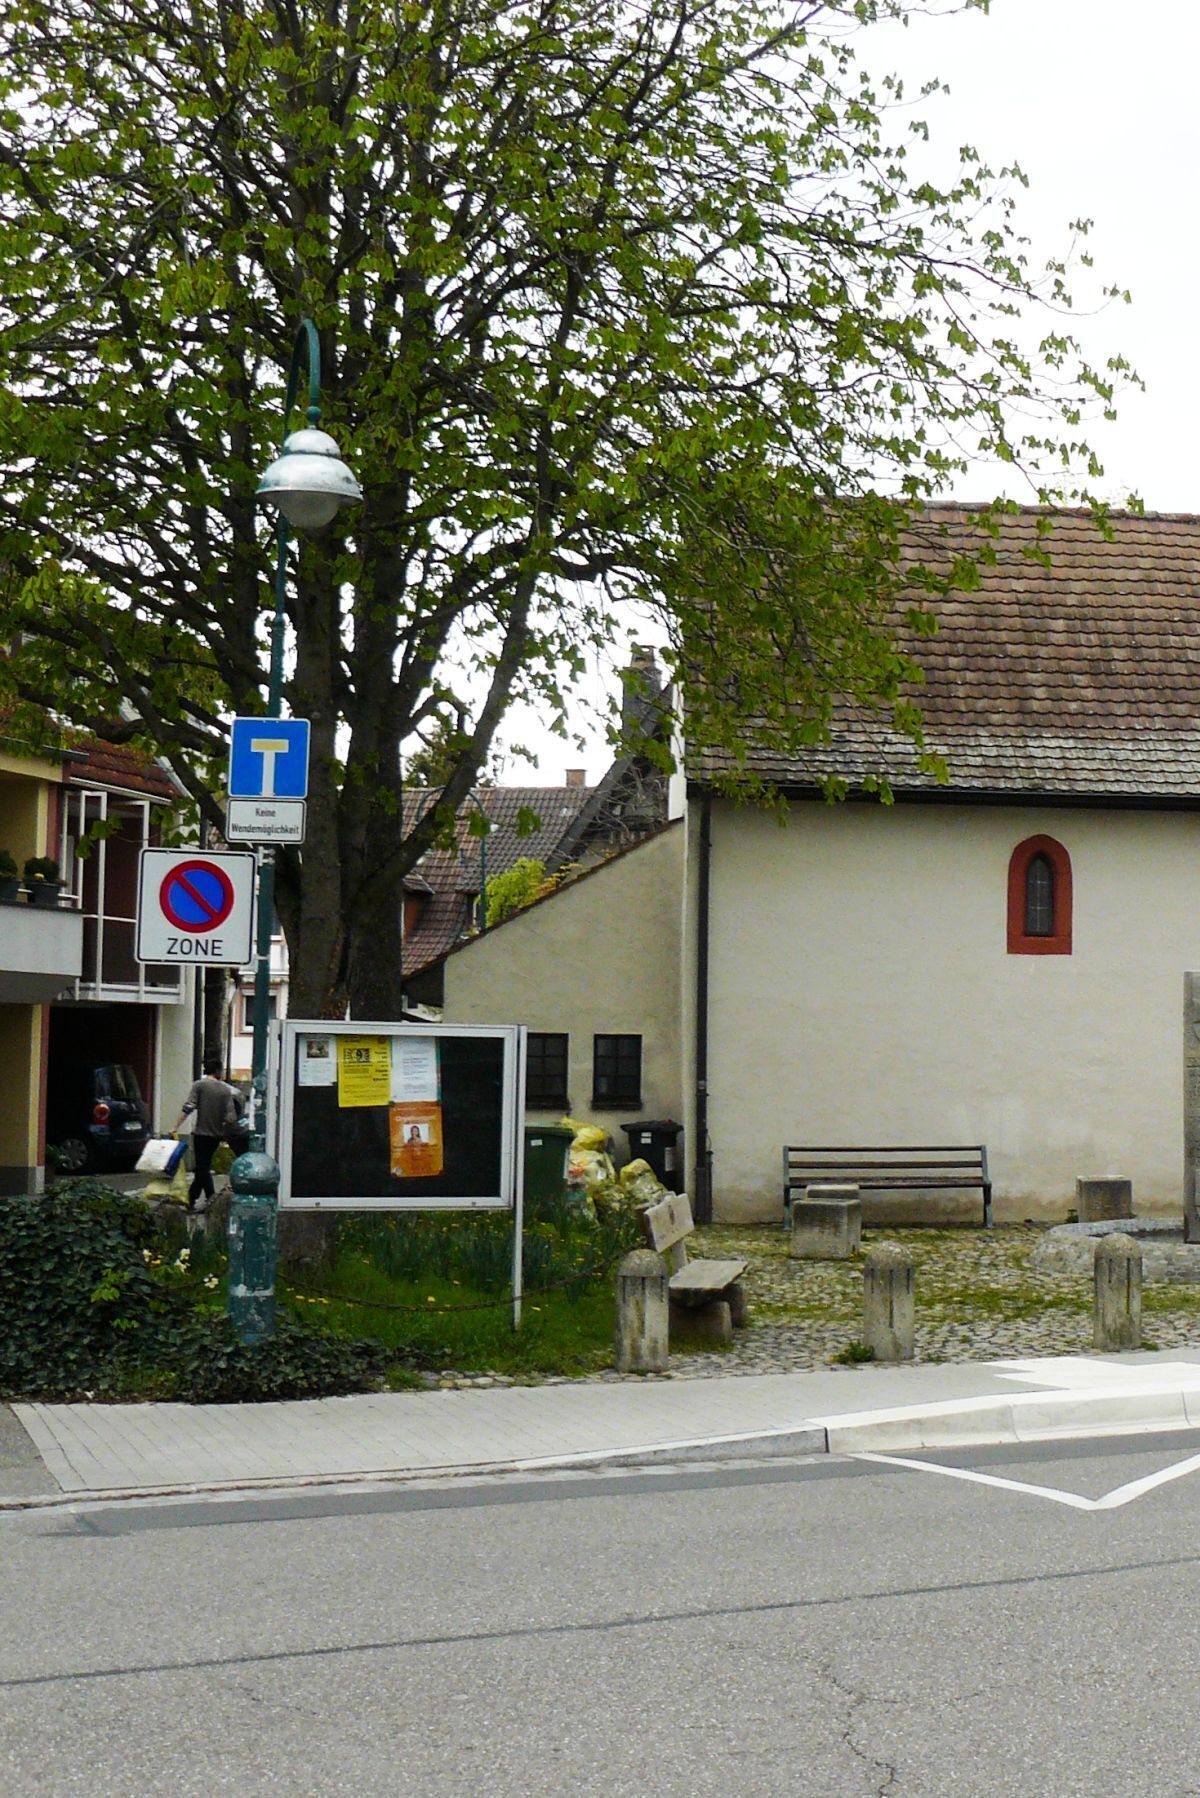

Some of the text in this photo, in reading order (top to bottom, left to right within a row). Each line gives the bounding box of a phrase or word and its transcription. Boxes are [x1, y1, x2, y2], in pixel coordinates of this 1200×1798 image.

[255, 807, 276, 817] Keine
[231, 823, 300, 836] Wendemöglichkeit
[167, 937, 223, 956] ZONE
